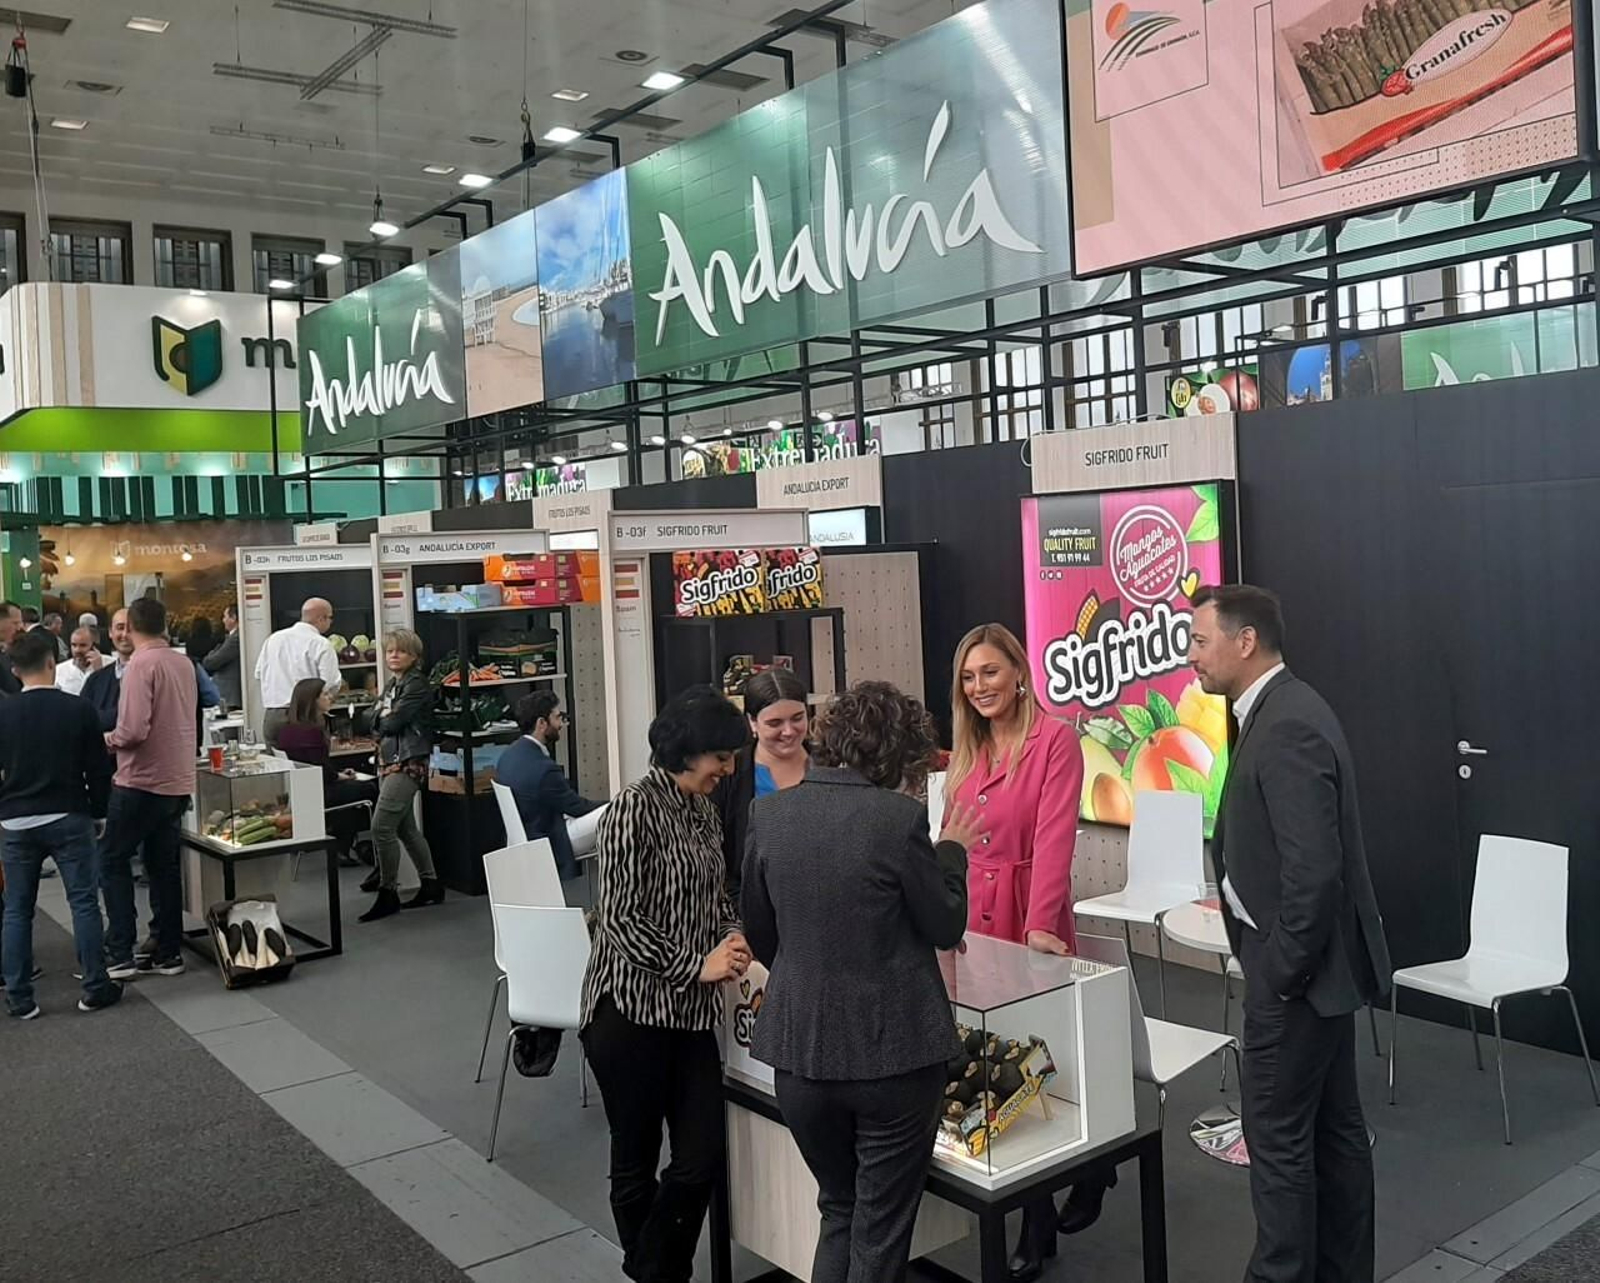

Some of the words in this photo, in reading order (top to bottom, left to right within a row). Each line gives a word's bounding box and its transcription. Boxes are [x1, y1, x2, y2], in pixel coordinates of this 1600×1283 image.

[1405, 13, 1507, 80] Granafresh
[648, 100, 1044, 347] Andalucía
[305, 308, 455, 437] Andalucía
[1084, 447, 1134, 466] SIGFRIDO
[1135, 443, 1169, 461] FRUIT
[821, 477, 849, 491] EXPORT
[466, 541, 495, 551] EXPORT
[657, 525, 700, 537] SIGFRIDO
[702, 524, 728, 536] FRUIT
[1044, 538, 1073, 553] QUALITY
[1075, 537, 1096, 550] FRUIT
[1120, 525, 1163, 563] Mangos
[277, 554, 304, 563] FRUTOS
[305, 554, 318, 562] LOS
[1119, 535, 1177, 582] Aguacates
[681, 564, 757, 602] Sigfrido
[768, 563, 816, 597] frido
[1048, 606, 1193, 701] Sigfrido
[738, 1011, 755, 1040] Si
